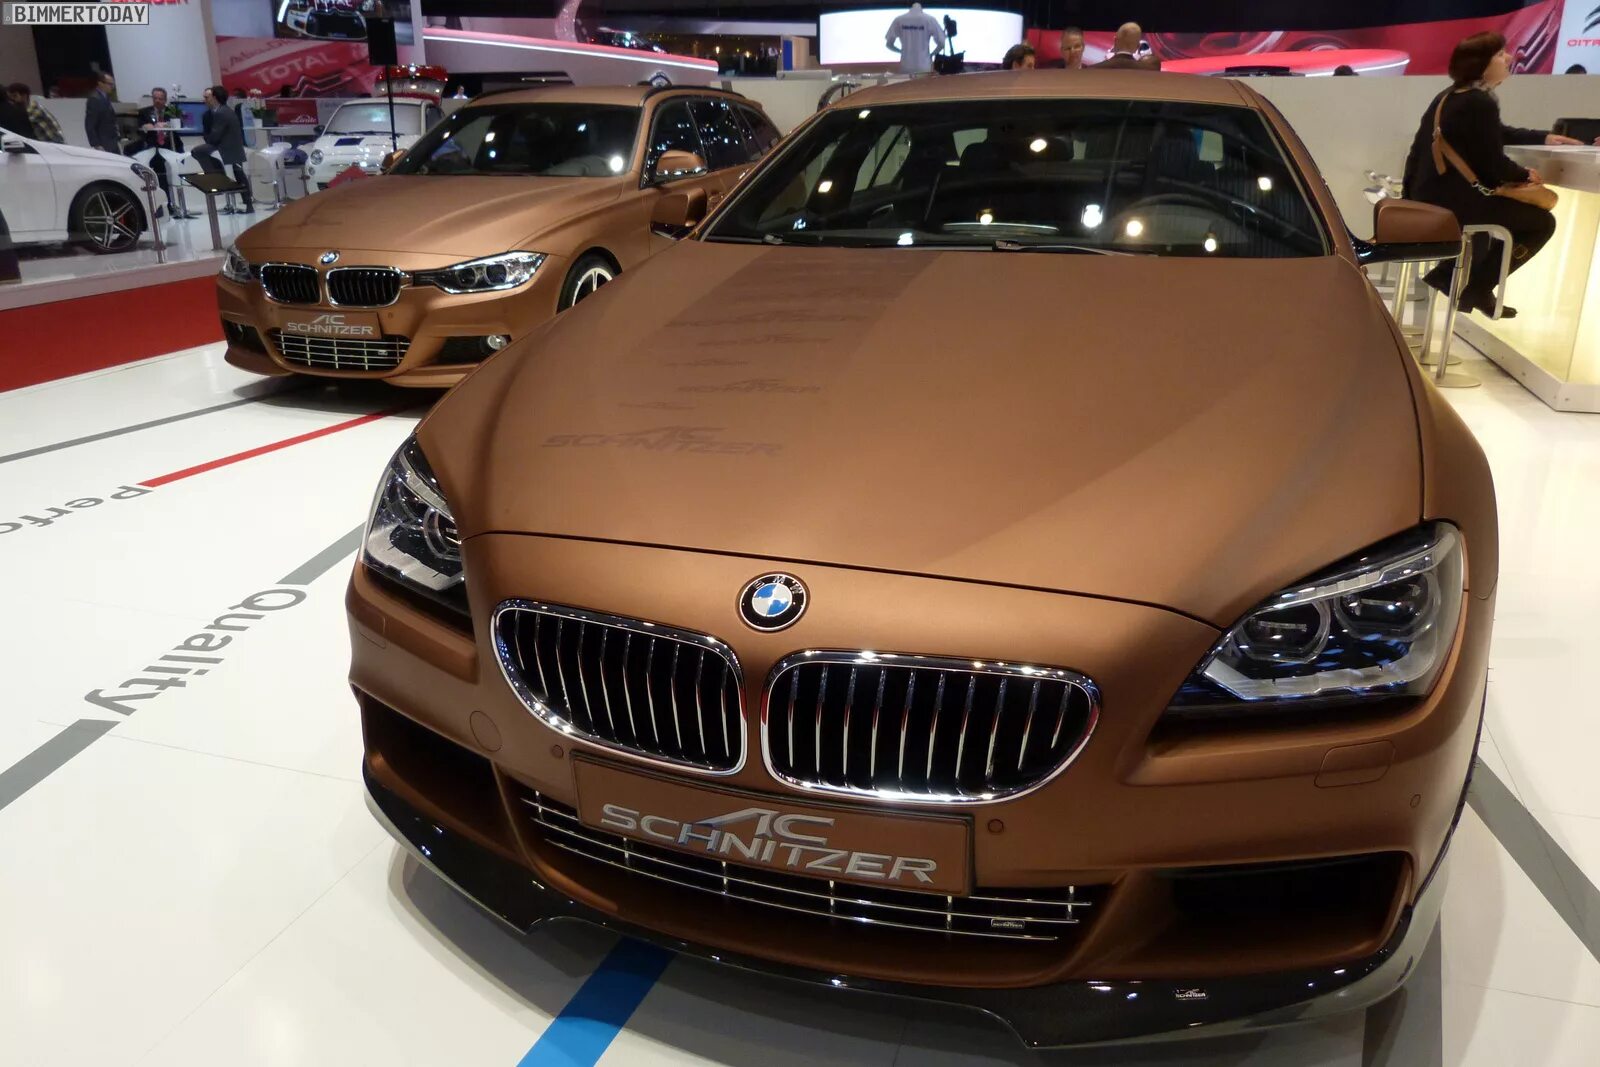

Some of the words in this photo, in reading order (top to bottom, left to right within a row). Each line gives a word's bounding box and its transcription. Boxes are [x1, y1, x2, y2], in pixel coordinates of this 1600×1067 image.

[253, 52, 339, 85] TOTAL
[287, 322, 374, 335] SCHNITZER
[312, 314, 345, 325] AC
[84, 588, 308, 717] Quality
[601, 803, 937, 885] SCHNITZER
[695, 806, 836, 847] AC
